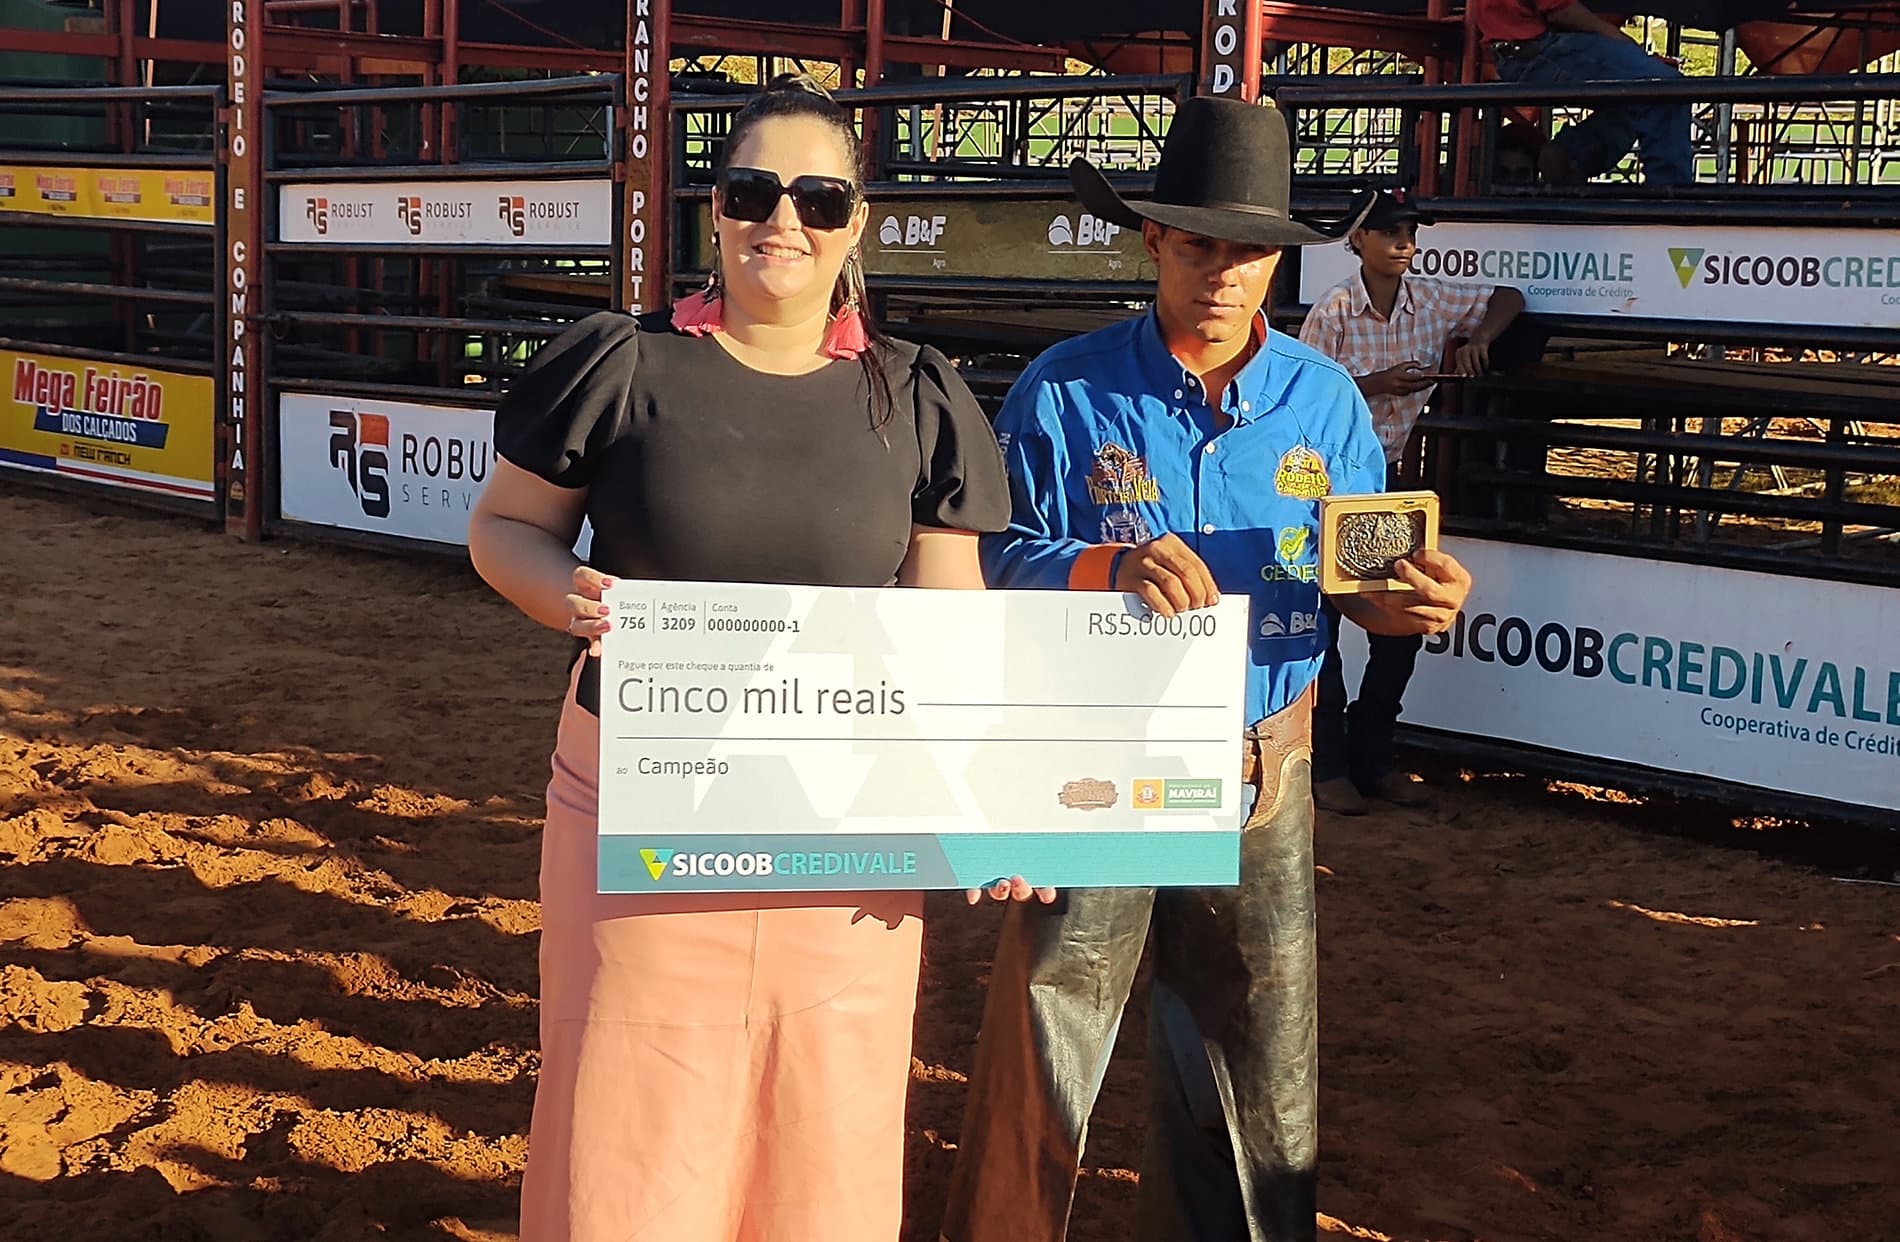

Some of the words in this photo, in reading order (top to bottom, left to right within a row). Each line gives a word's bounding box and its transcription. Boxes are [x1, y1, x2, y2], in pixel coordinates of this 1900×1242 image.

[231, 0, 246, 157] RODEIO
[633, 0, 649, 159] RANCHO
[234, 188, 245, 210] E
[425, 202, 472, 218] ROBUST
[331, 203, 373, 218] ROBUST
[529, 202, 580, 219] ROBUST
[904, 215, 947, 246] B&F
[1408, 247, 1634, 282] COOBCREDIVALE
[1527, 284, 1583, 298] Cooperativa
[1585, 285, 1597, 297] de
[231, 240, 246, 470] COMPANHIA
[13, 358, 77, 416] Mega
[83, 366, 163, 422] Feirão
[61, 412, 82, 434] DOS
[83, 415, 137, 443] CALÇADOS
[402, 433, 488, 483] ROBU
[1260, 564, 1319, 583] GEDE
[619, 601, 647, 611] Banco
[660, 602, 697, 613] Agência
[711, 602, 738, 612] Conta
[619, 616, 646, 630] 756
[661, 617, 696, 631] 3209
[707, 618, 800, 633] 000000000-1
[1290, 611, 1317, 634] B&
[618, 660, 646, 671] Pague
[648, 662, 663, 672] por
[665, 662, 684, 671] este
[686, 661, 719, 673] cheque
[728, 662, 761, 673] quantia
[618, 677, 729, 713] Cinco
[743, 678, 803, 715] mil
[816, 680, 906, 716] reais
[1700, 707, 1810, 742] Cooperativa
[1815, 725, 1840, 746] de
[638, 756, 730, 778] Campeão
